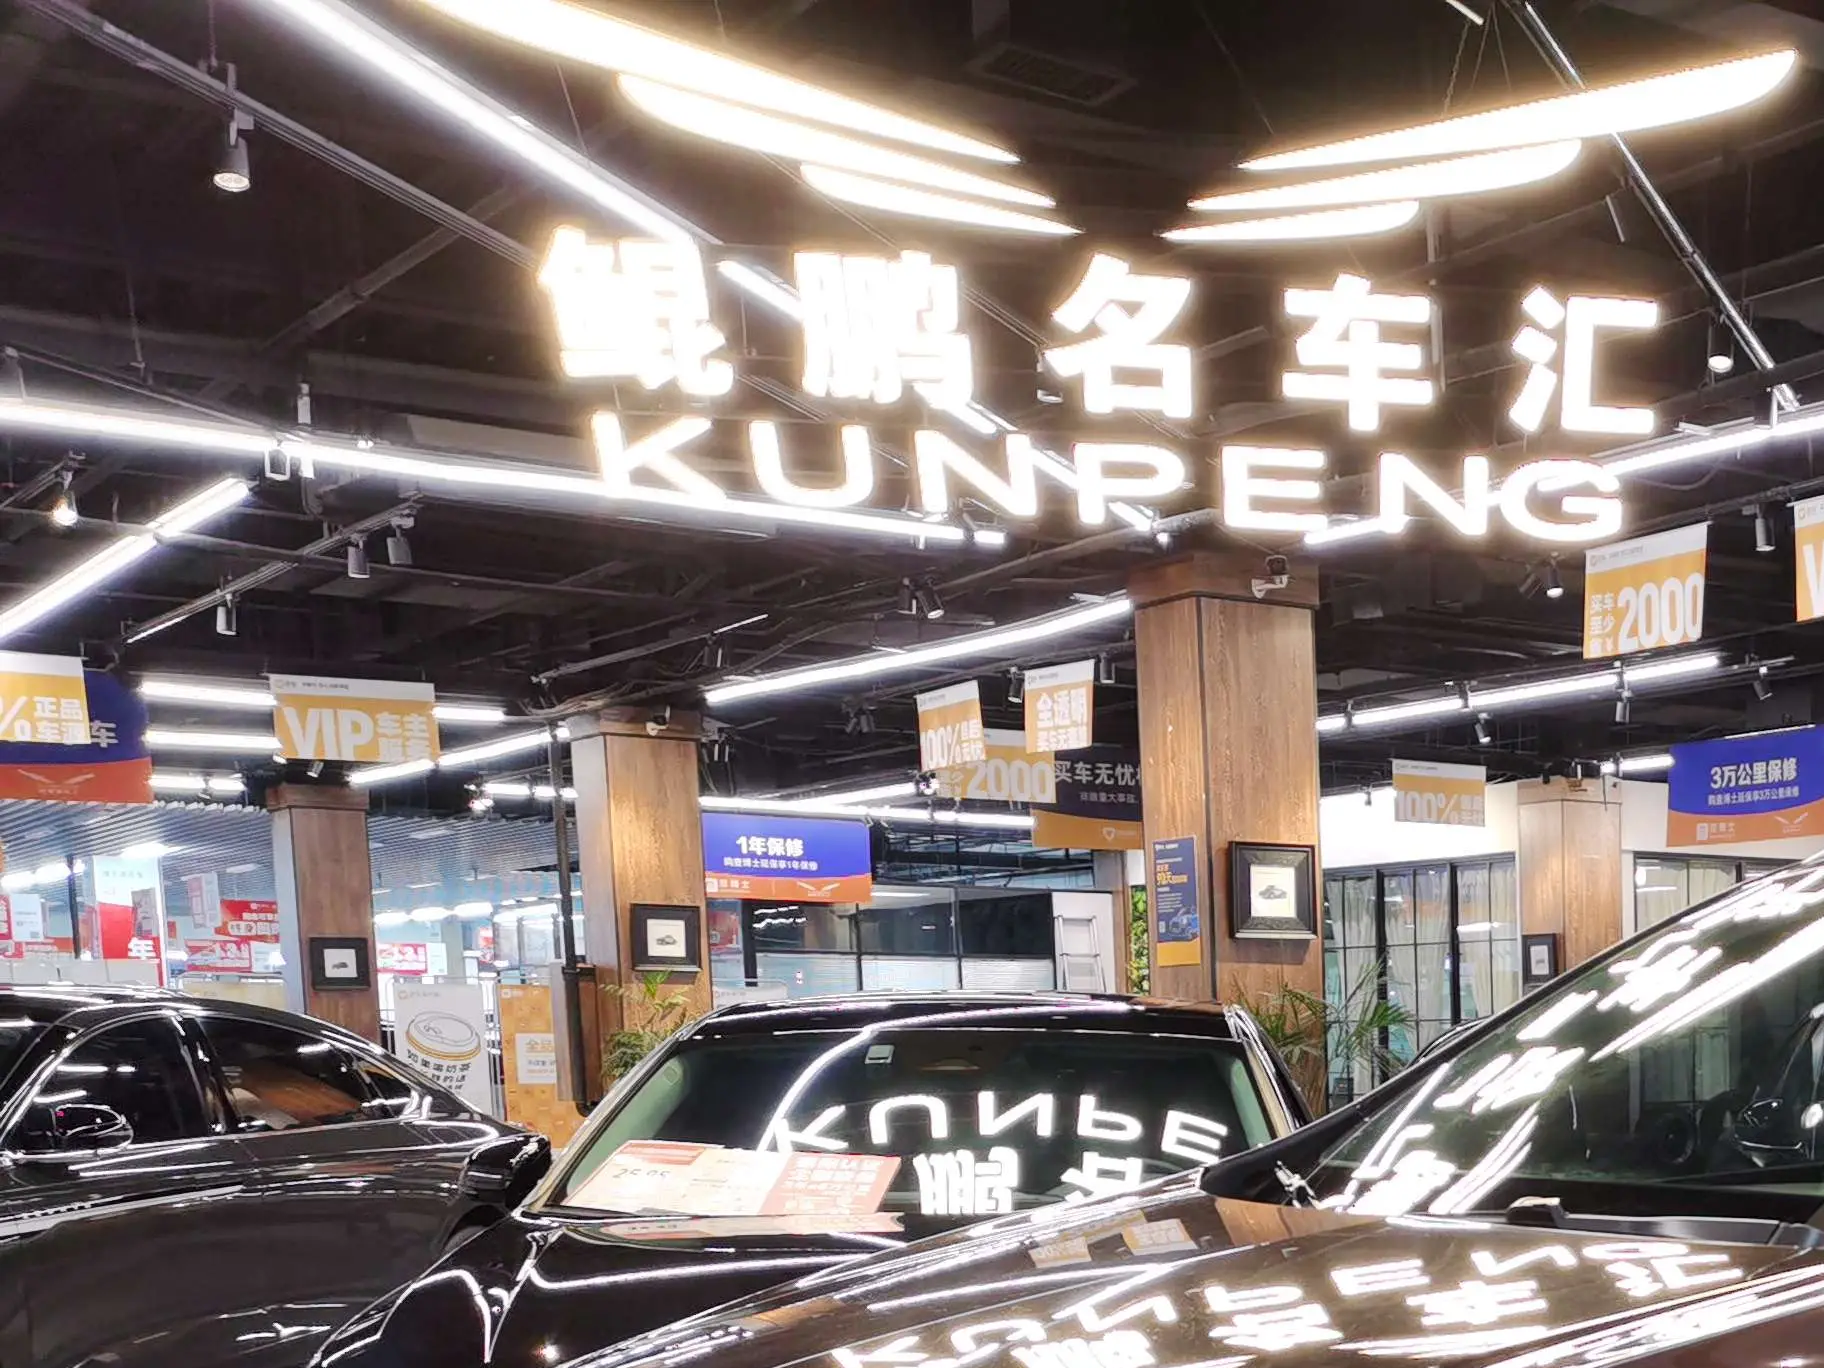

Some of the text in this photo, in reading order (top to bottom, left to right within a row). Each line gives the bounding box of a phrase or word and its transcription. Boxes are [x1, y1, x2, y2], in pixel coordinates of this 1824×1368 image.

[592, 411, 1622, 541] KUNPENG
[1618, 572, 1704, 652] 2000
[33, 696, 82, 720] 正品
[282, 707, 374, 760] VIP
[921, 723, 962, 770] 100%
[967, 758, 1053, 802] 2000
[1055, 760, 1140, 786] 买车无忧
[1710, 757, 1798, 789] 3万公里保修
[736, 836, 804, 857] 1年保修
